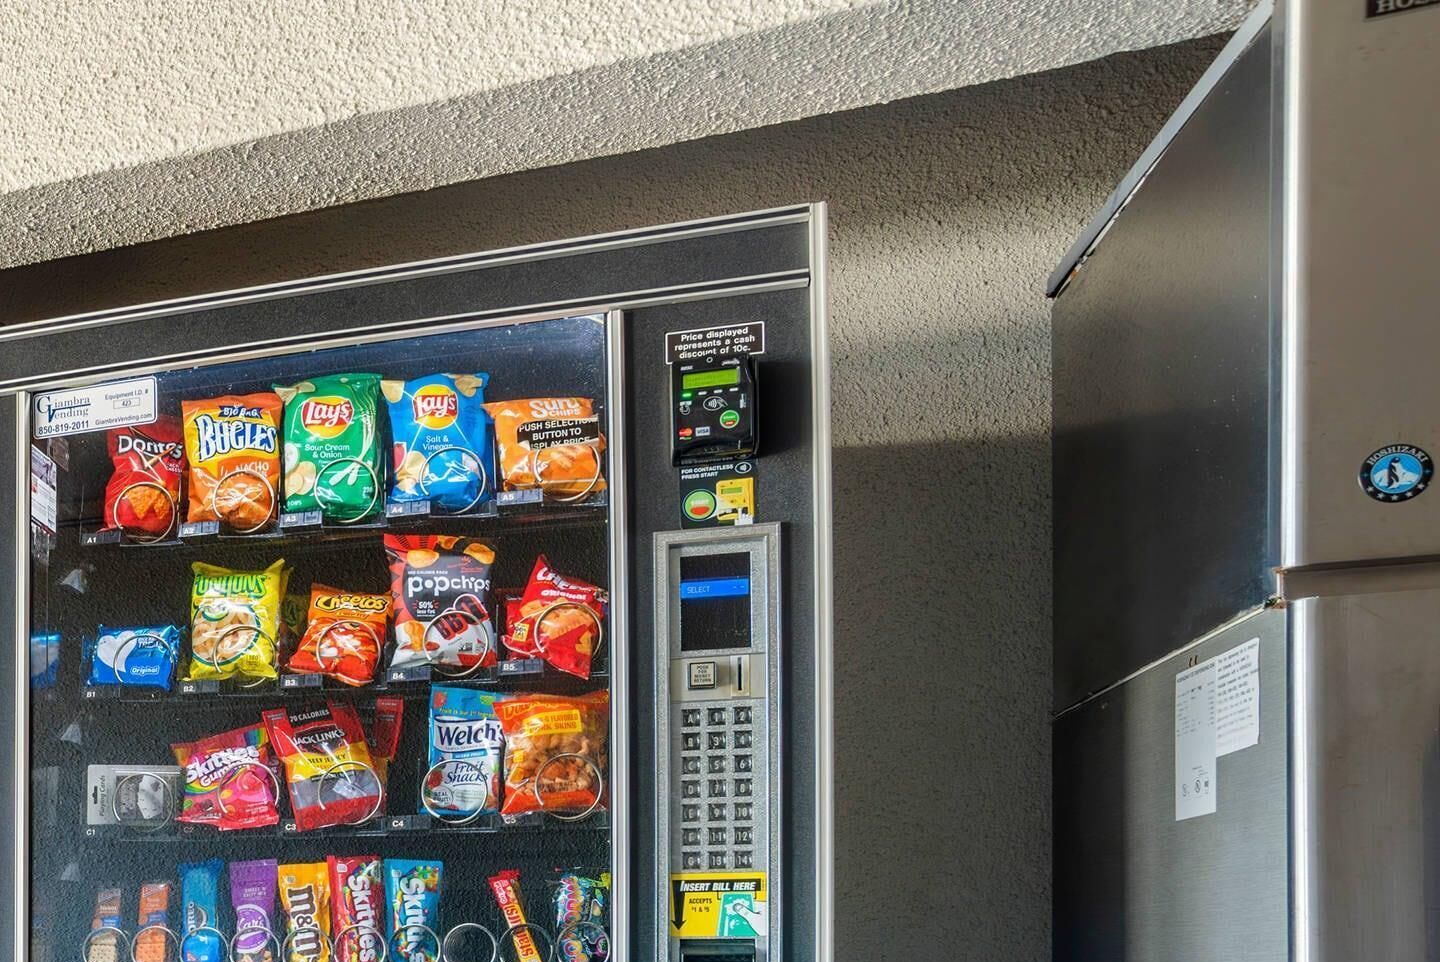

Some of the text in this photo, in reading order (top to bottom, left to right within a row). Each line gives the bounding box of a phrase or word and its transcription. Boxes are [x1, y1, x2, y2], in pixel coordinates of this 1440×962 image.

[681, 327, 749, 342] Price displayed
[674, 339, 722, 351] represents
[734, 335, 755, 344] cash
[679, 346, 730, 359] discount of
[37, 391, 134, 414] Giambra Equipment
[416, 396, 456, 418] Lay's
[48, 406, 89, 423] Vending
[95, 412, 153, 426] GiambraVending.com
[305, 399, 352, 427] Lay's
[38, 420, 89, 435] 850-819-2011
[518, 422, 543, 432] PUSH
[426, 435, 441, 443] Salt
[532, 427, 582, 440] BUTTON TO
[118, 435, 183, 459] Doritos
[304, 443, 350, 451] Sour Cream
[319, 450, 342, 458] Onion
[1366, 445, 1429, 465] HOSHIZAKI
[693, 464, 734, 473] CONTACTLESS
[502, 493, 514, 501] A5
[391, 506, 403, 514] A4
[408, 575, 491, 598] popchips
[686, 585, 710, 594] SELECT
[317, 594, 385, 610] Cheetos
[418, 601, 434, 609] 50%
[131, 667, 159, 675] Original
[298, 709, 330, 720] CALORIES
[688, 712, 745, 724] A 1 2
[437, 722, 505, 746] Welch's
[293, 735, 314, 746] JACK
[712, 736, 720, 748] 3
[739, 735, 745, 746] 4
[185, 745, 260, 784] Skittles
[454, 761, 484, 774] Fruit
[688, 760, 746, 771] C 5 6
[444, 772, 489, 784] Snacks
[688, 784, 746, 794] D 7 8
[714, 808, 720, 818] 9
[738, 808, 748, 817] 10
[285, 824, 296, 832] C3
[392, 820, 404, 828] C4
[86, 828, 96, 836] C1
[712, 832, 722, 841] 11
[738, 832, 748, 841] 12
[712, 856, 722, 866] 13
[738, 855, 748, 865] 14
[680, 880, 756, 892] INSERT BILL HERE
[187, 901, 197, 936] OREO
